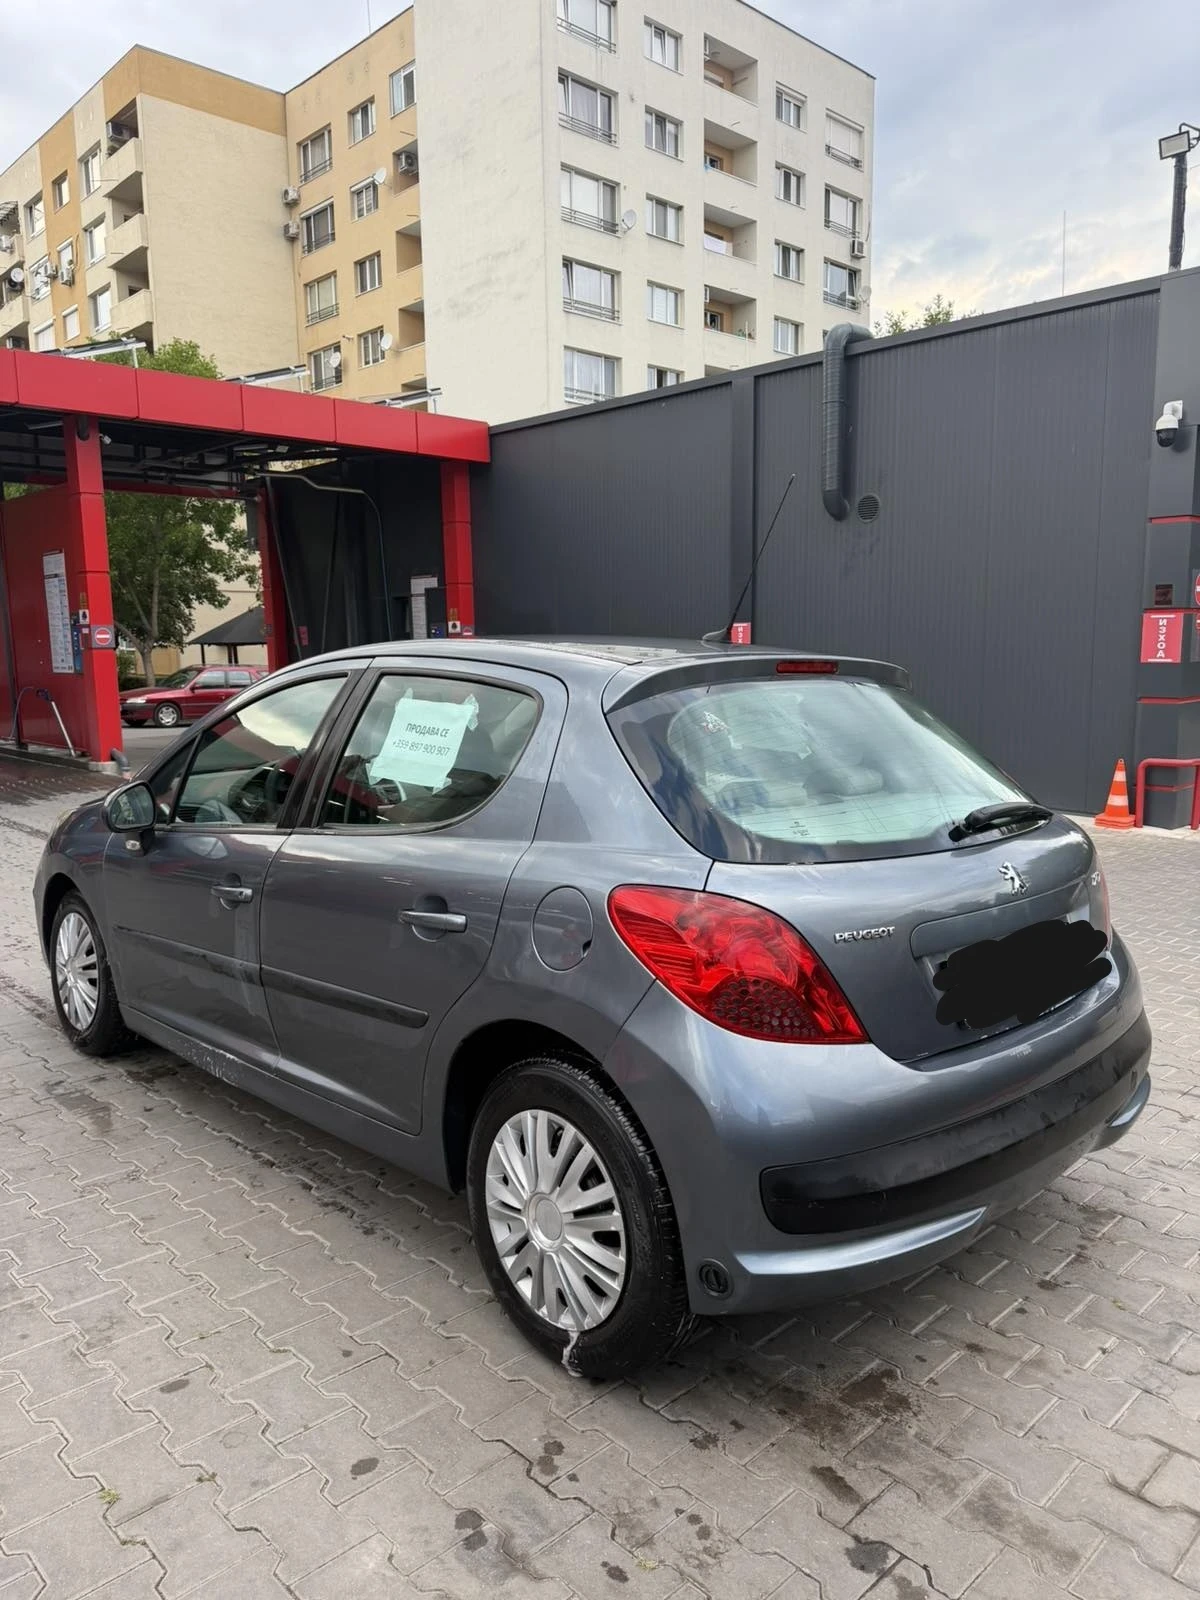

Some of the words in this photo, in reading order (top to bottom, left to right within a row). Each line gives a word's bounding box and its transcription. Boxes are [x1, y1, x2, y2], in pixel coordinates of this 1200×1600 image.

[405, 723, 439, 737] ПРОДАВА
[440, 728, 450, 738] СЕ
[393, 739, 409, 750] +359
[409, 741, 423, 752] 897
[422, 743, 436, 754] 900
[436, 745, 450, 756] 907
[834, 926, 896, 944] PEUGEOT
